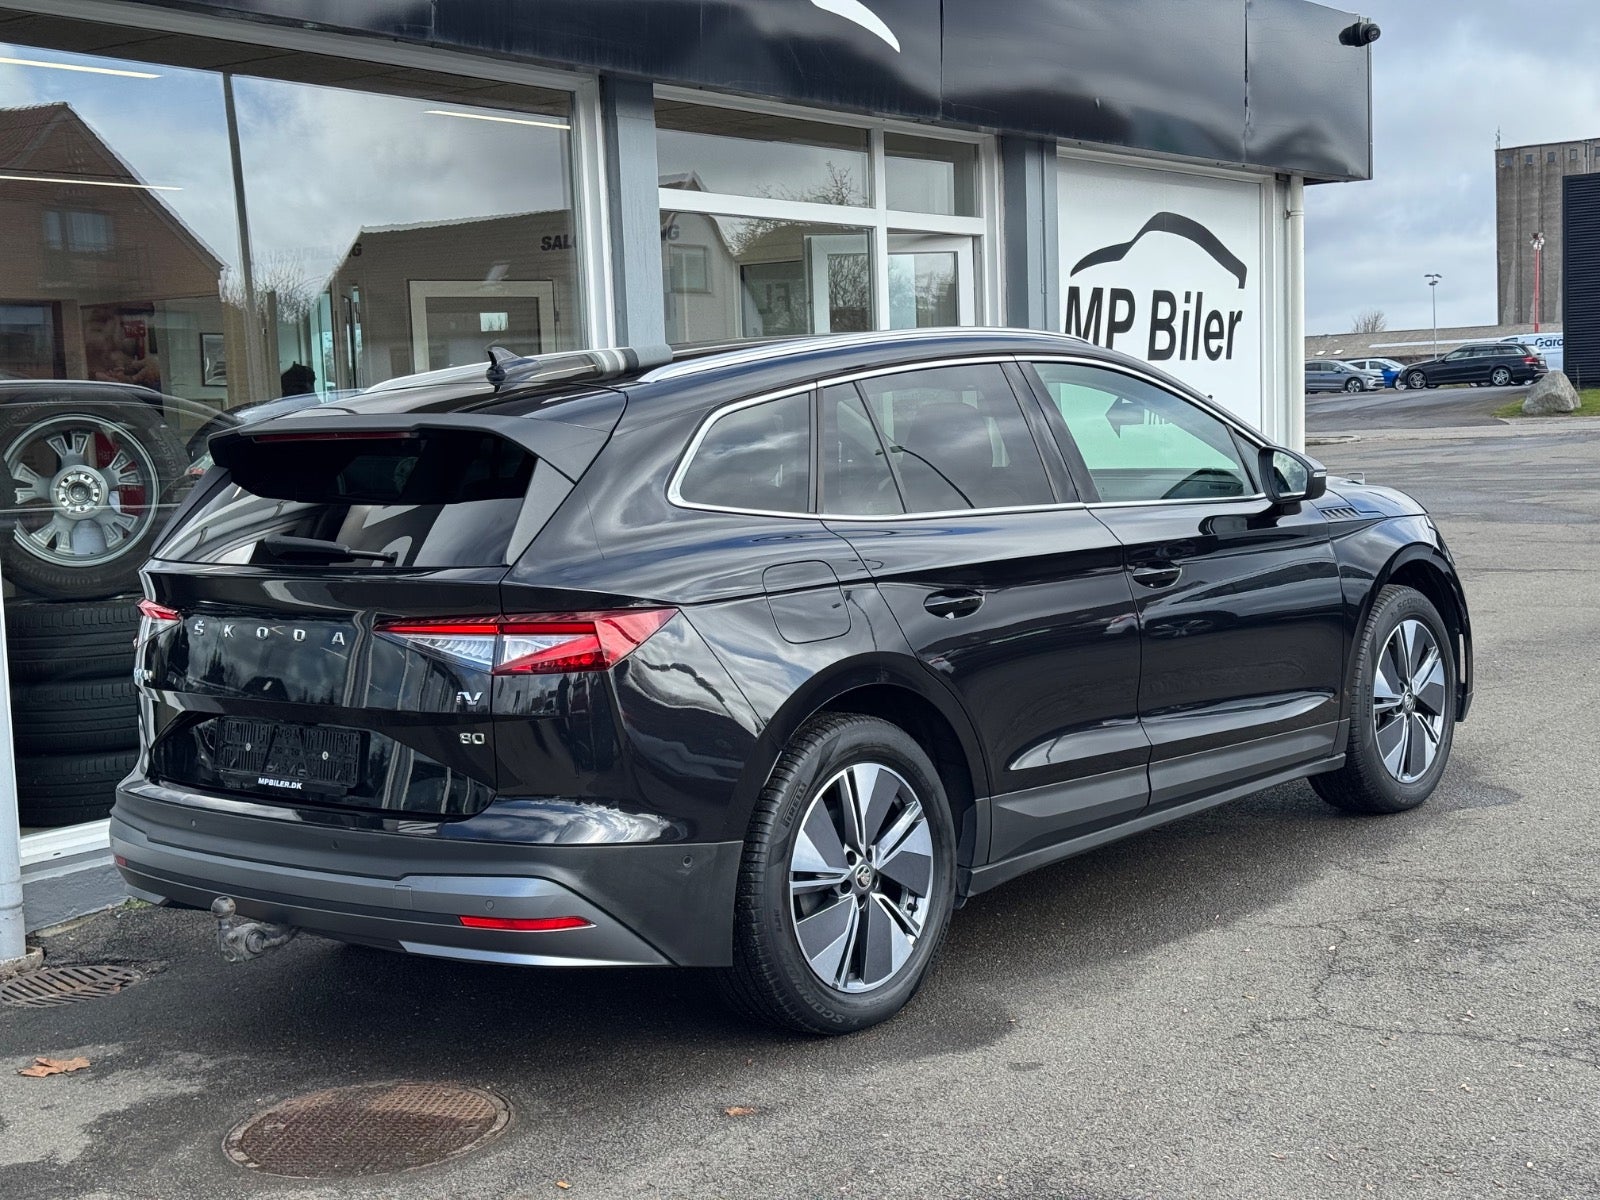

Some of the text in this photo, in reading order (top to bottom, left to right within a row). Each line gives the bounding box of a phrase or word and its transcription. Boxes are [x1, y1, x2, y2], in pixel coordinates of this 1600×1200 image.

[541, 234, 577, 252] SAL
[1064, 285, 1243, 361] MP Biler
[193, 619, 346, 646] ŠKODA
[459, 732, 486, 745] 80
[257, 776, 303, 790] MPBILER.DK
